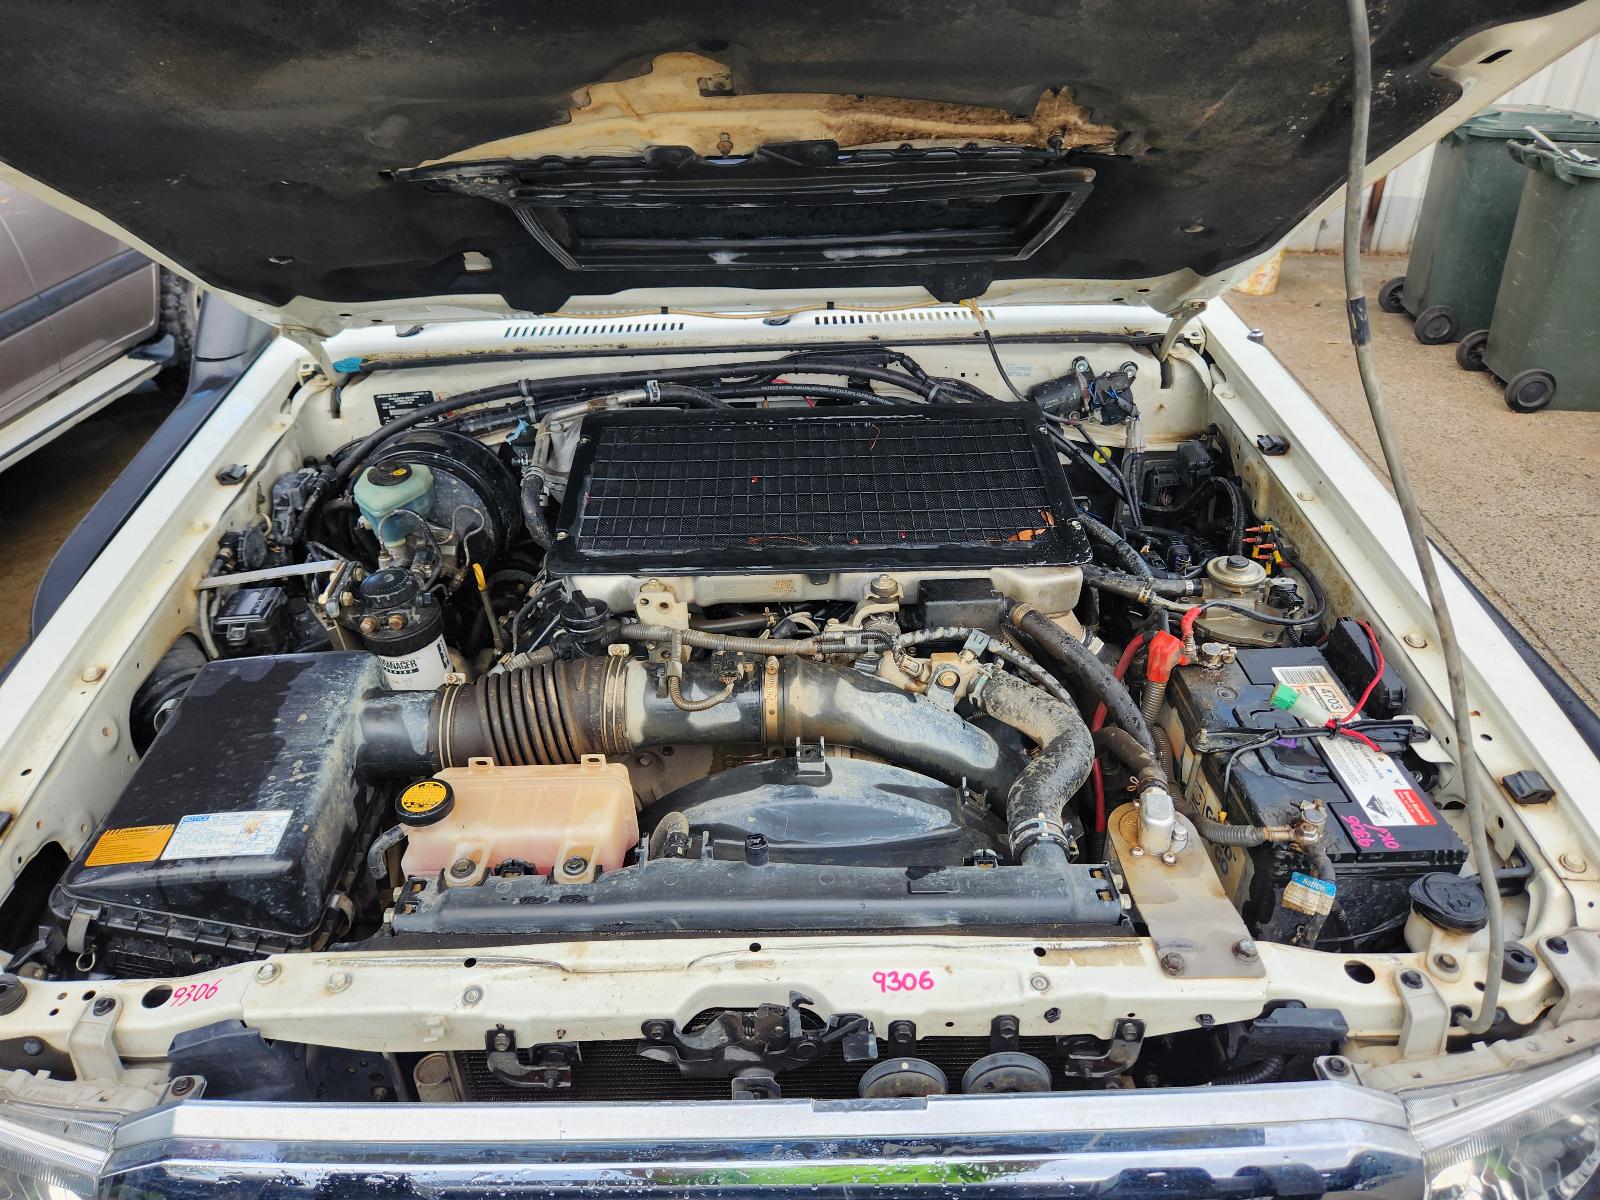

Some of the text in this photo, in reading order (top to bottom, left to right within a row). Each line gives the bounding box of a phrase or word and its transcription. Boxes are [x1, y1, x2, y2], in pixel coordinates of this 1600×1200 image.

[1321, 688, 1343, 710] 4703
[169, 977, 224, 1007] 9306
[872, 970, 935, 993] 9306
